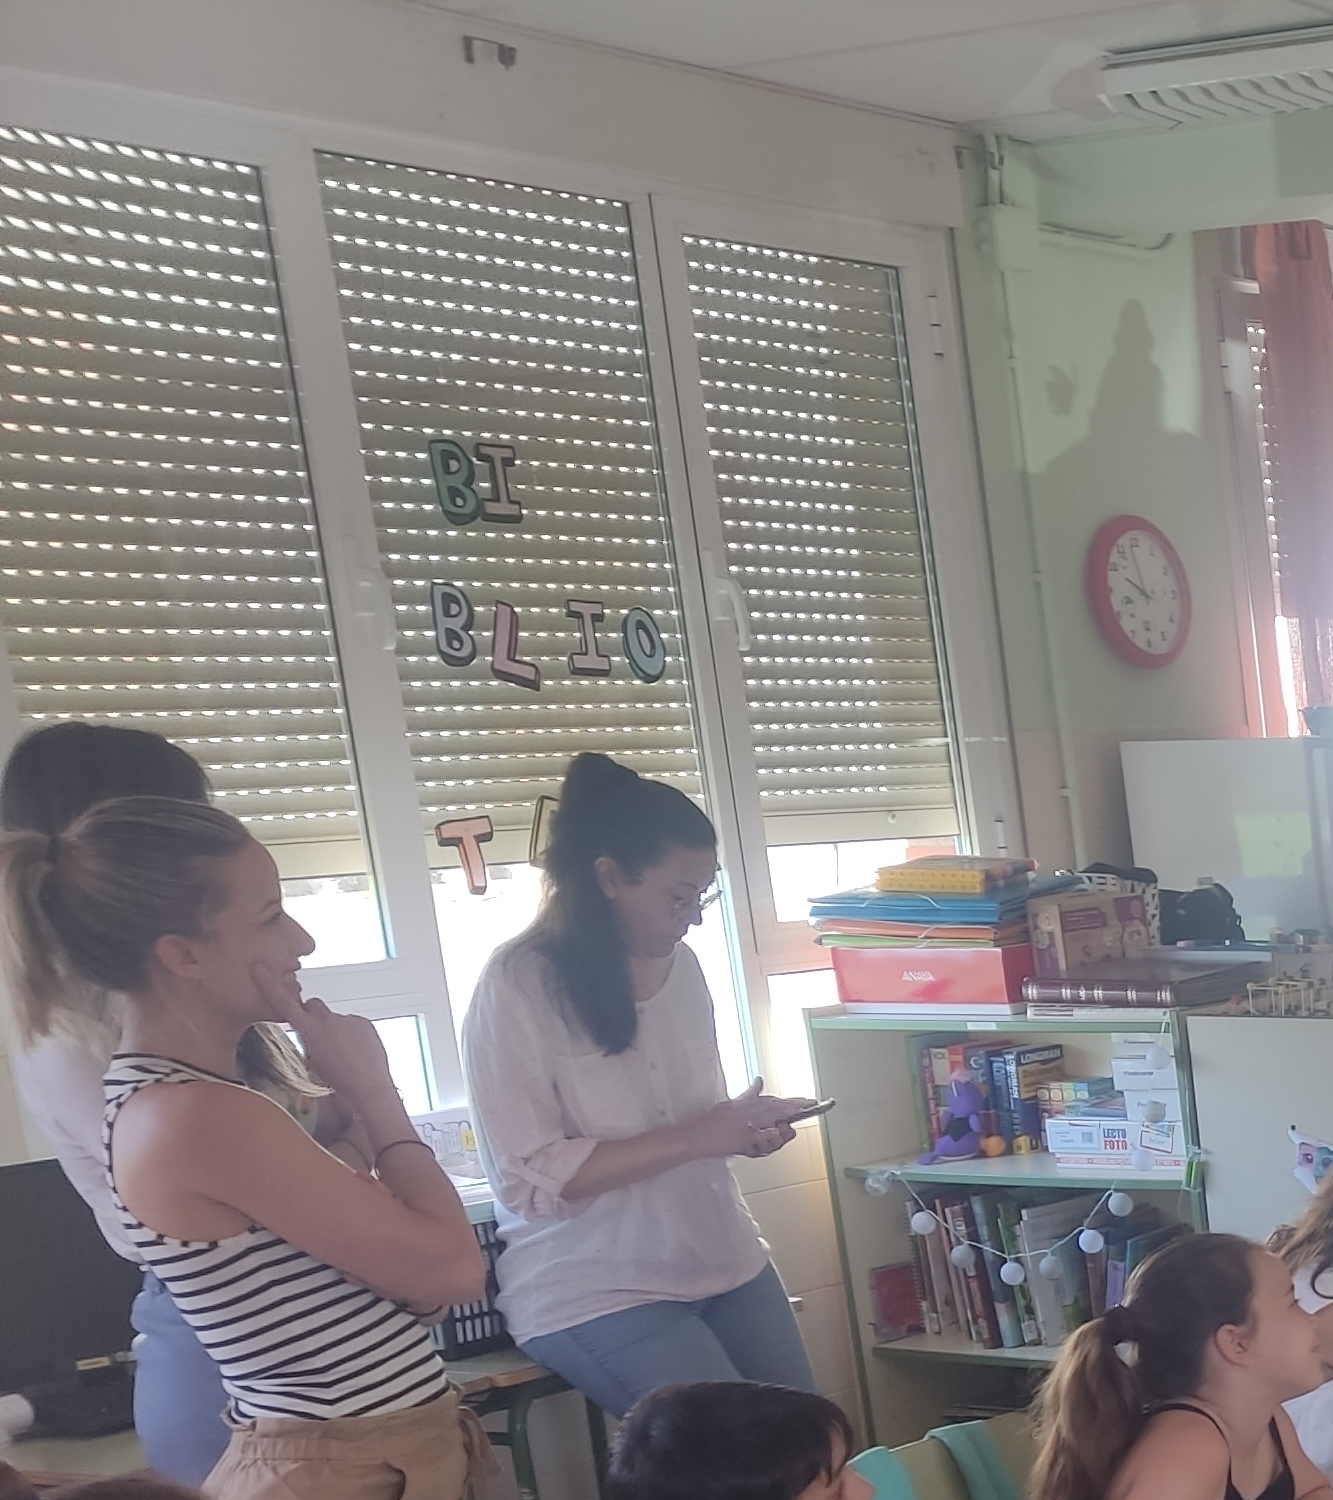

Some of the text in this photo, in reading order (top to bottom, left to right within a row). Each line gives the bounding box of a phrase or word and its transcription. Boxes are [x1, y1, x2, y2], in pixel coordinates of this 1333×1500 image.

[428, 438, 523, 524] BI
[430, 580, 666, 691] BLIO
[902, 970, 936, 982] ANAYA
